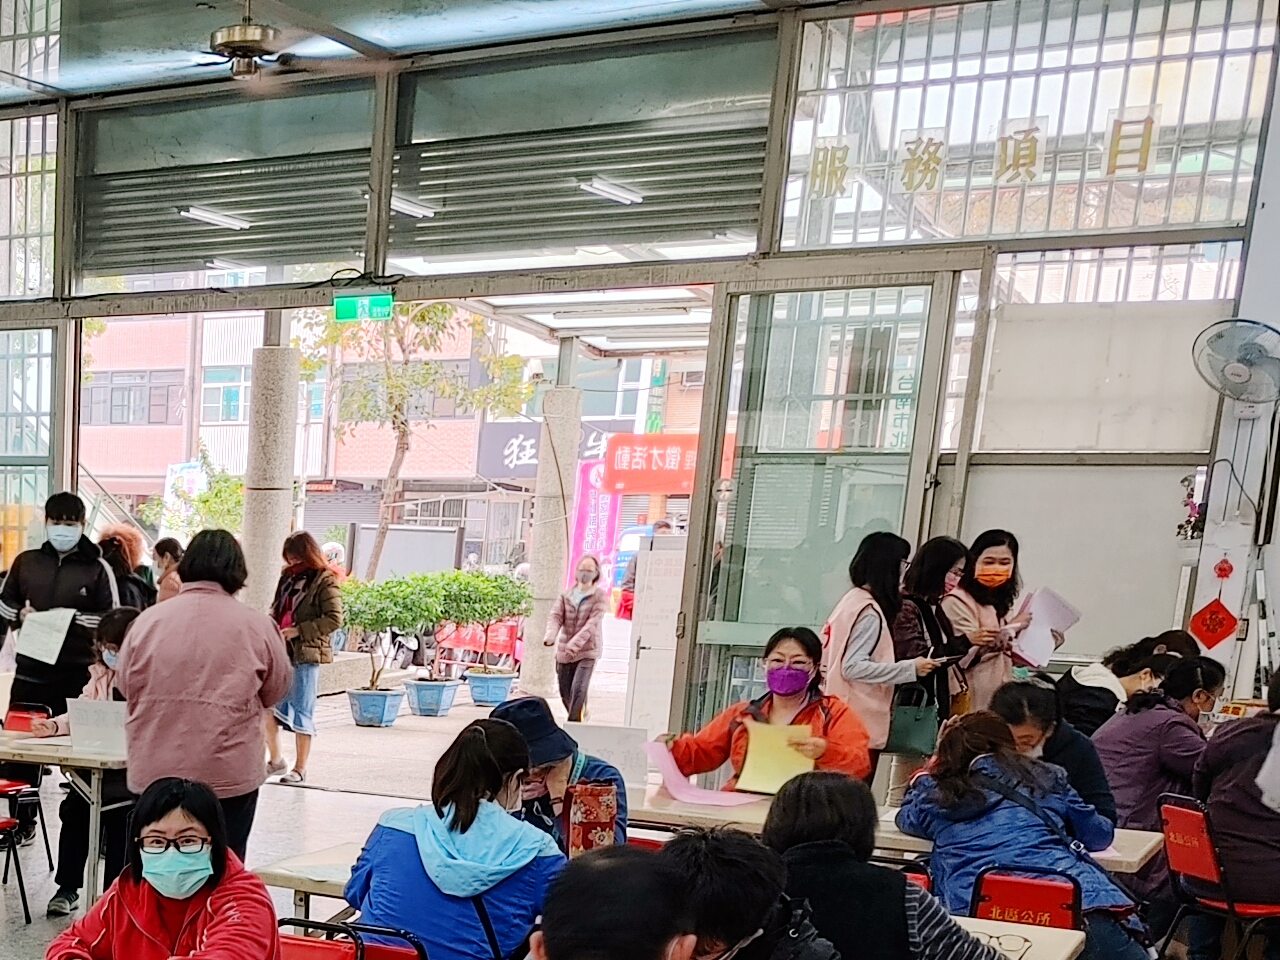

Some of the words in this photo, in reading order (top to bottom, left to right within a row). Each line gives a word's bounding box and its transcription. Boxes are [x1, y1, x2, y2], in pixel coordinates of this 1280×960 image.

[808, 115, 1154, 200] 服務項目
[503, 433, 539, 469] 狂
[988, 905, 1051, 926] 北區公所
